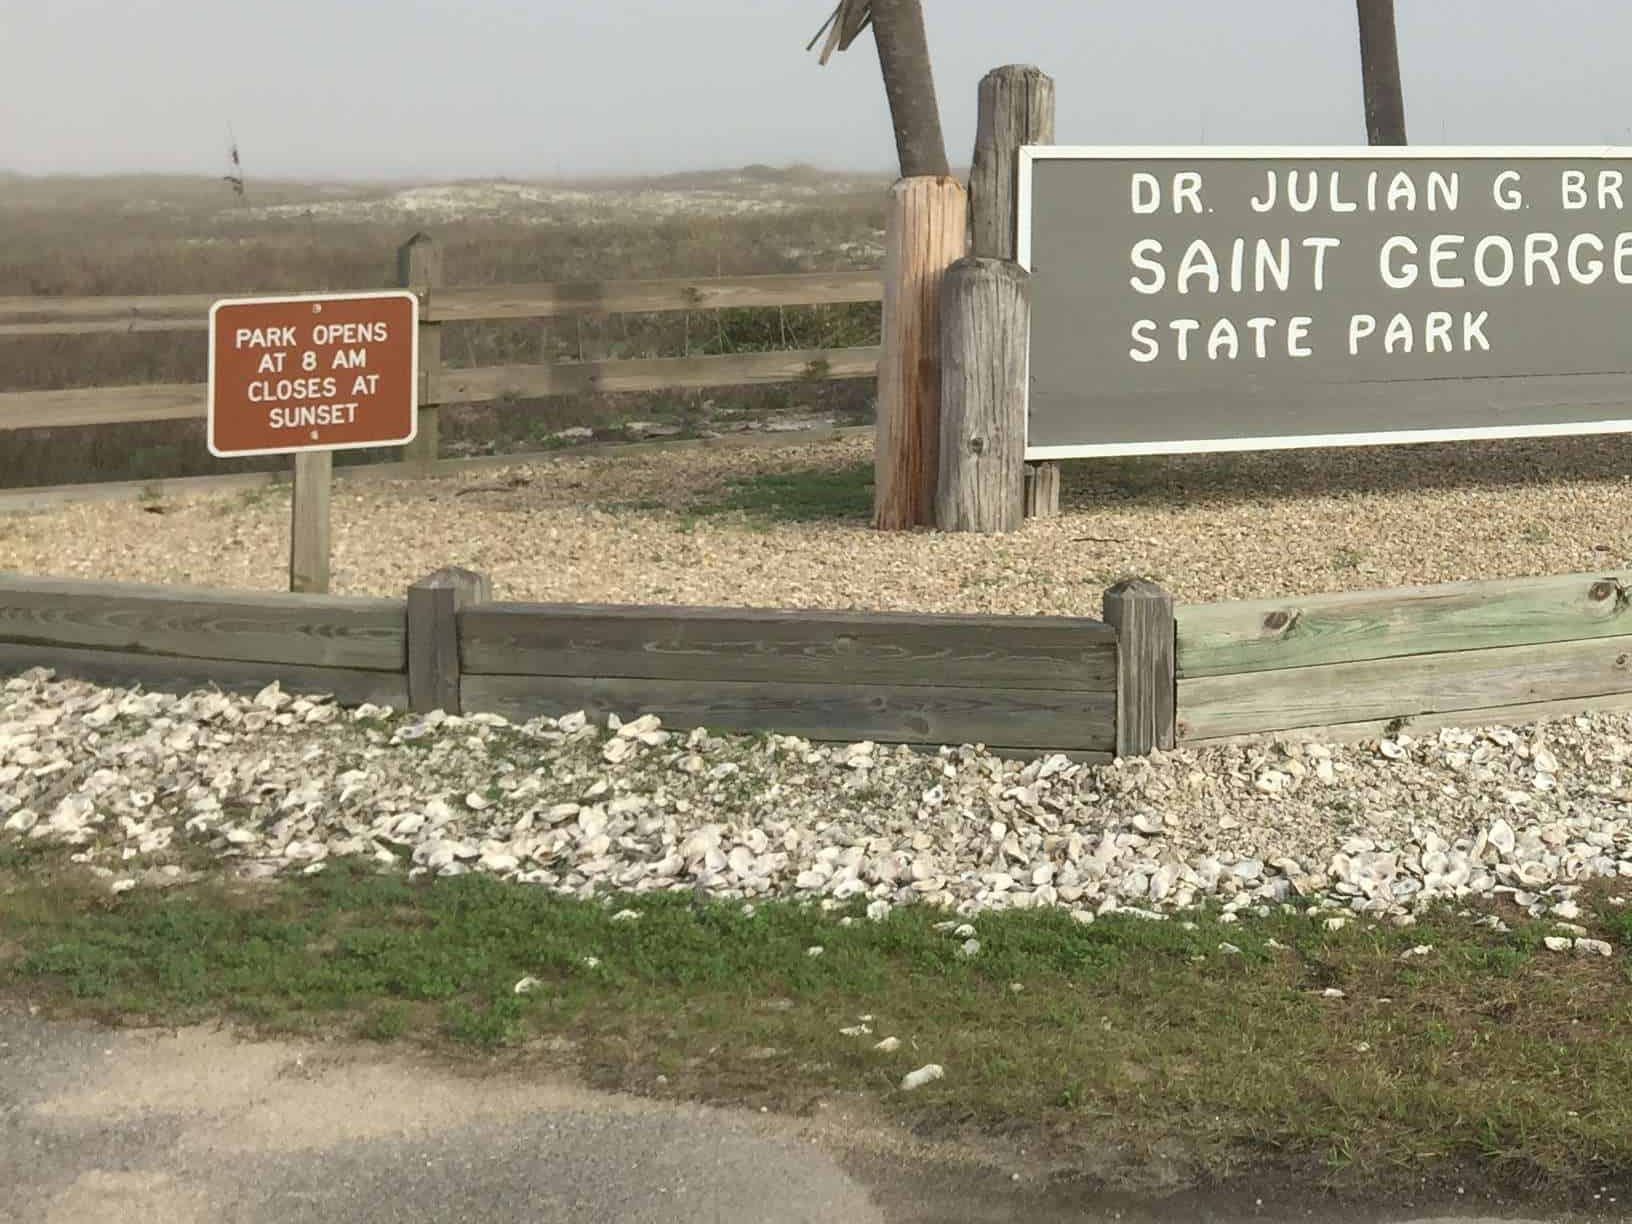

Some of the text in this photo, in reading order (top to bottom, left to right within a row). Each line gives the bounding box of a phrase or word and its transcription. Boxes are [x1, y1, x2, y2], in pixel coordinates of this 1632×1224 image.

[1132, 172, 1214, 213] DR.
[1250, 171, 1459, 212] JULIAN
[1130, 237, 1341, 294] SAINT
[235, 322, 388, 349] PARK OPENS
[1129, 311, 1490, 361] STATE PARK
[257, 348, 367, 374] AT 8 AM
[247, 374, 380, 402] CLOSES AT
[269, 402, 359, 429] SUNSET
